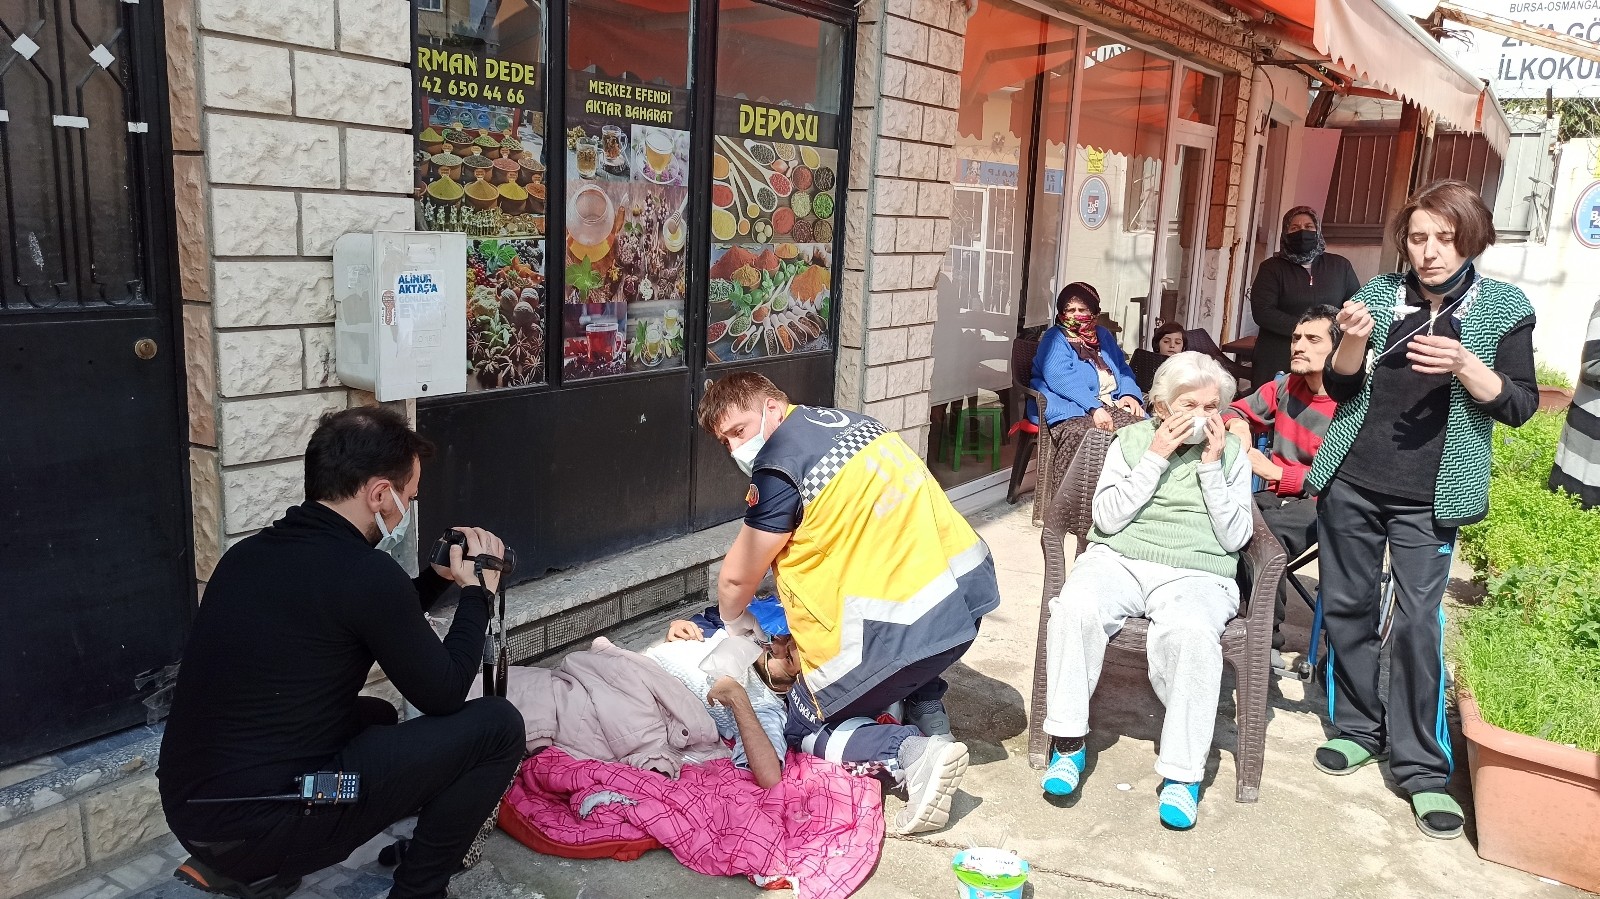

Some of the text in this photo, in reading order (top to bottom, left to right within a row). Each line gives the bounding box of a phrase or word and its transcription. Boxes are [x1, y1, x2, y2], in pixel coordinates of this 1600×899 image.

[1509, 0, 1600, 13] BURSA-OSMANGA
[485, 58, 535, 86] DEDE
[418, 75, 525, 104] 42 650 44 66
[589, 79, 671, 105] MERKEZ EFENDİ
[585, 99, 673, 124] AKTAR BAHARAT
[739, 103, 819, 143] DEPOSU
[398, 273, 432, 284] ALİNUR
[398, 283, 438, 295] AKTAŞ'A
